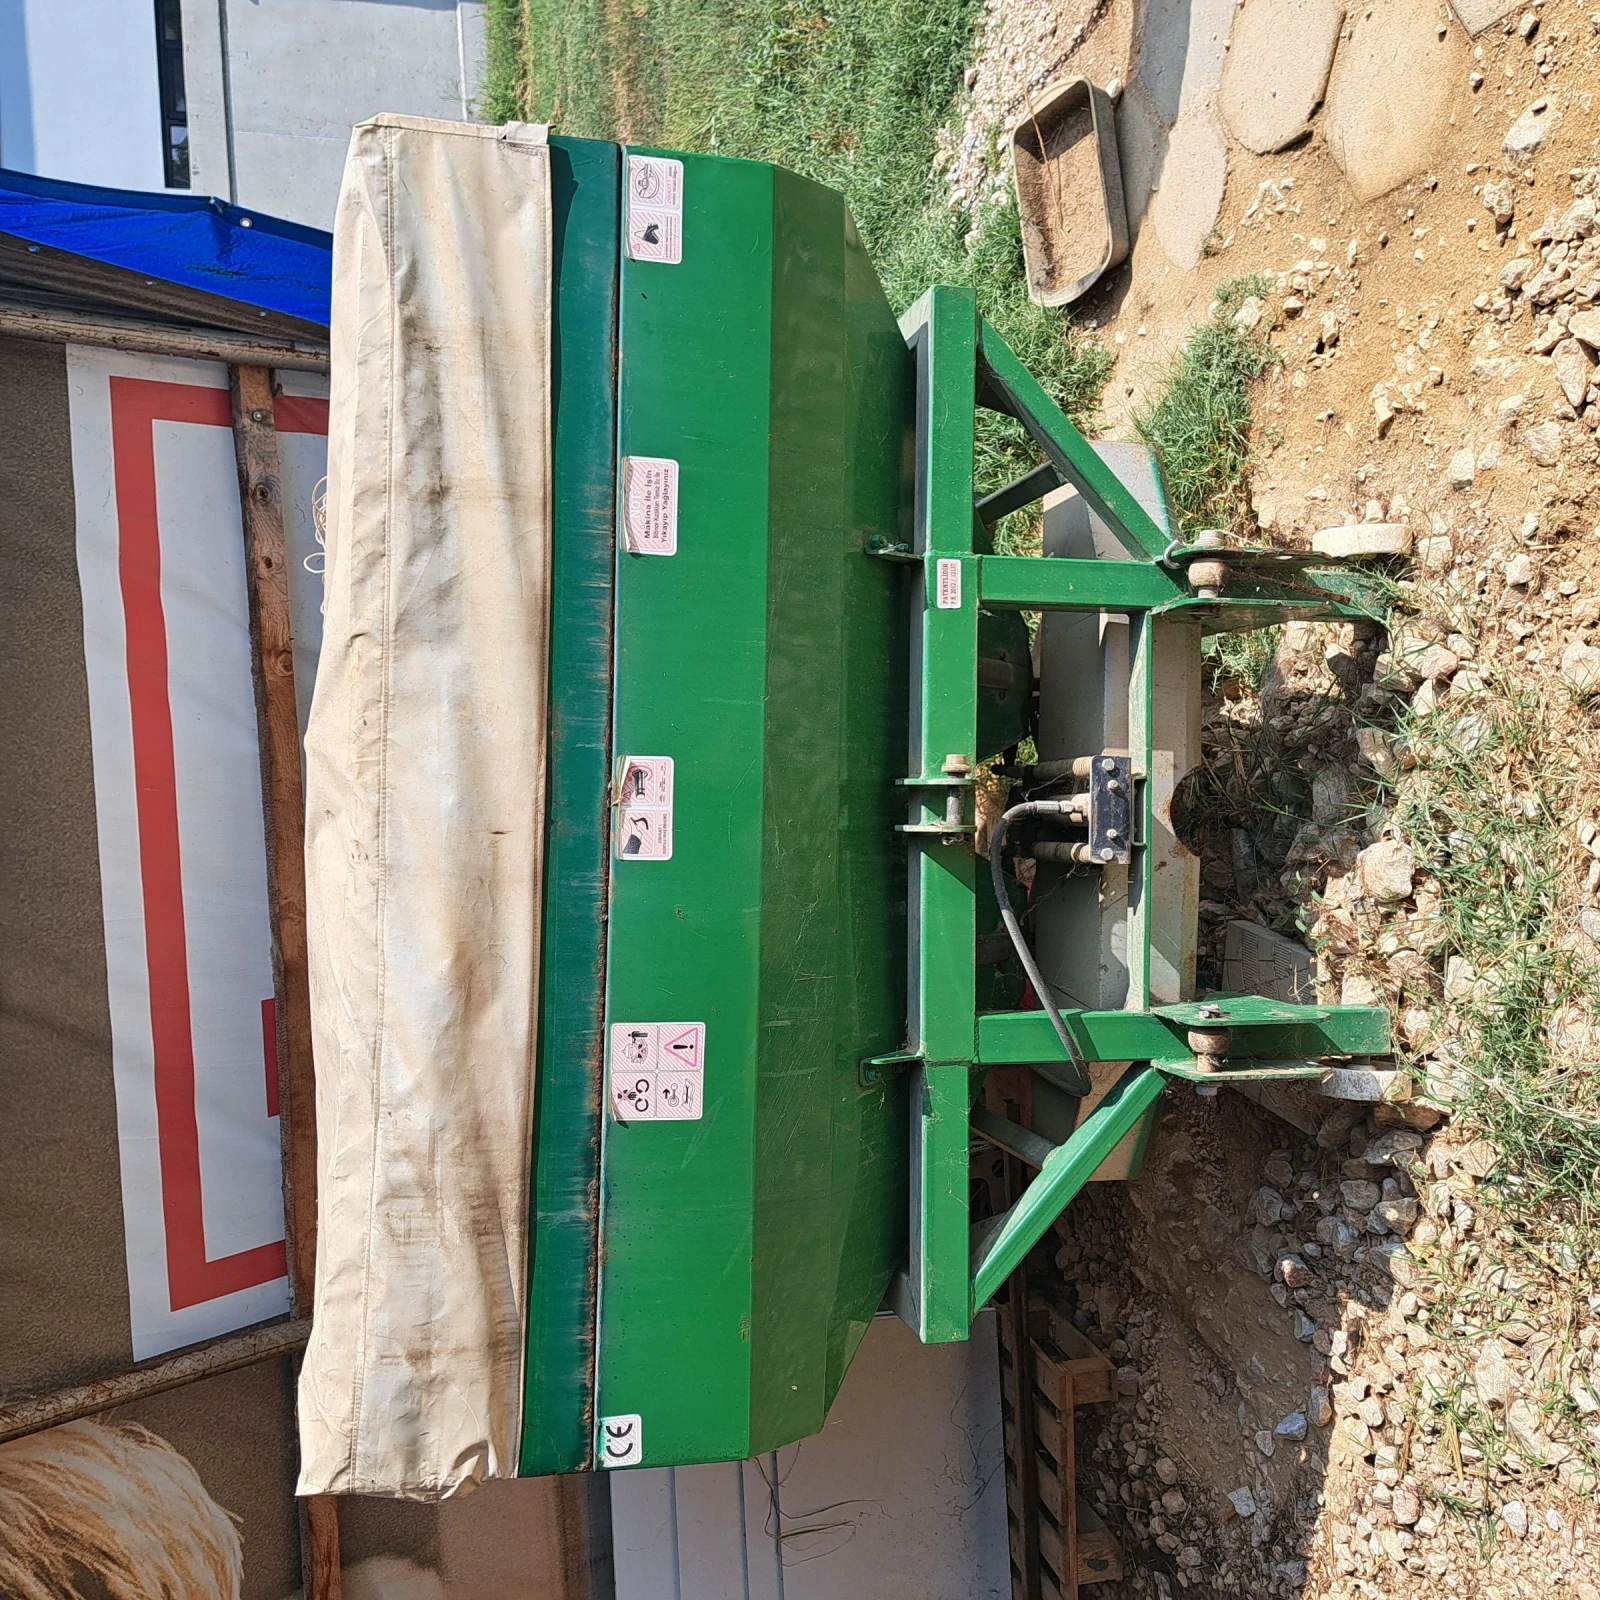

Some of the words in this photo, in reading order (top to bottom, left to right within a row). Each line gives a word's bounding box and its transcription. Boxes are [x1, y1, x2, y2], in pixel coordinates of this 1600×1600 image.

[661, 468, 669, 511] Yağlayınız
[644, 504, 652, 539] Makina
[661, 512, 669, 543] Yıkayıp
[941, 563, 949, 604] PATENTLİDİR
[605, 1423, 633, 1458] CE
